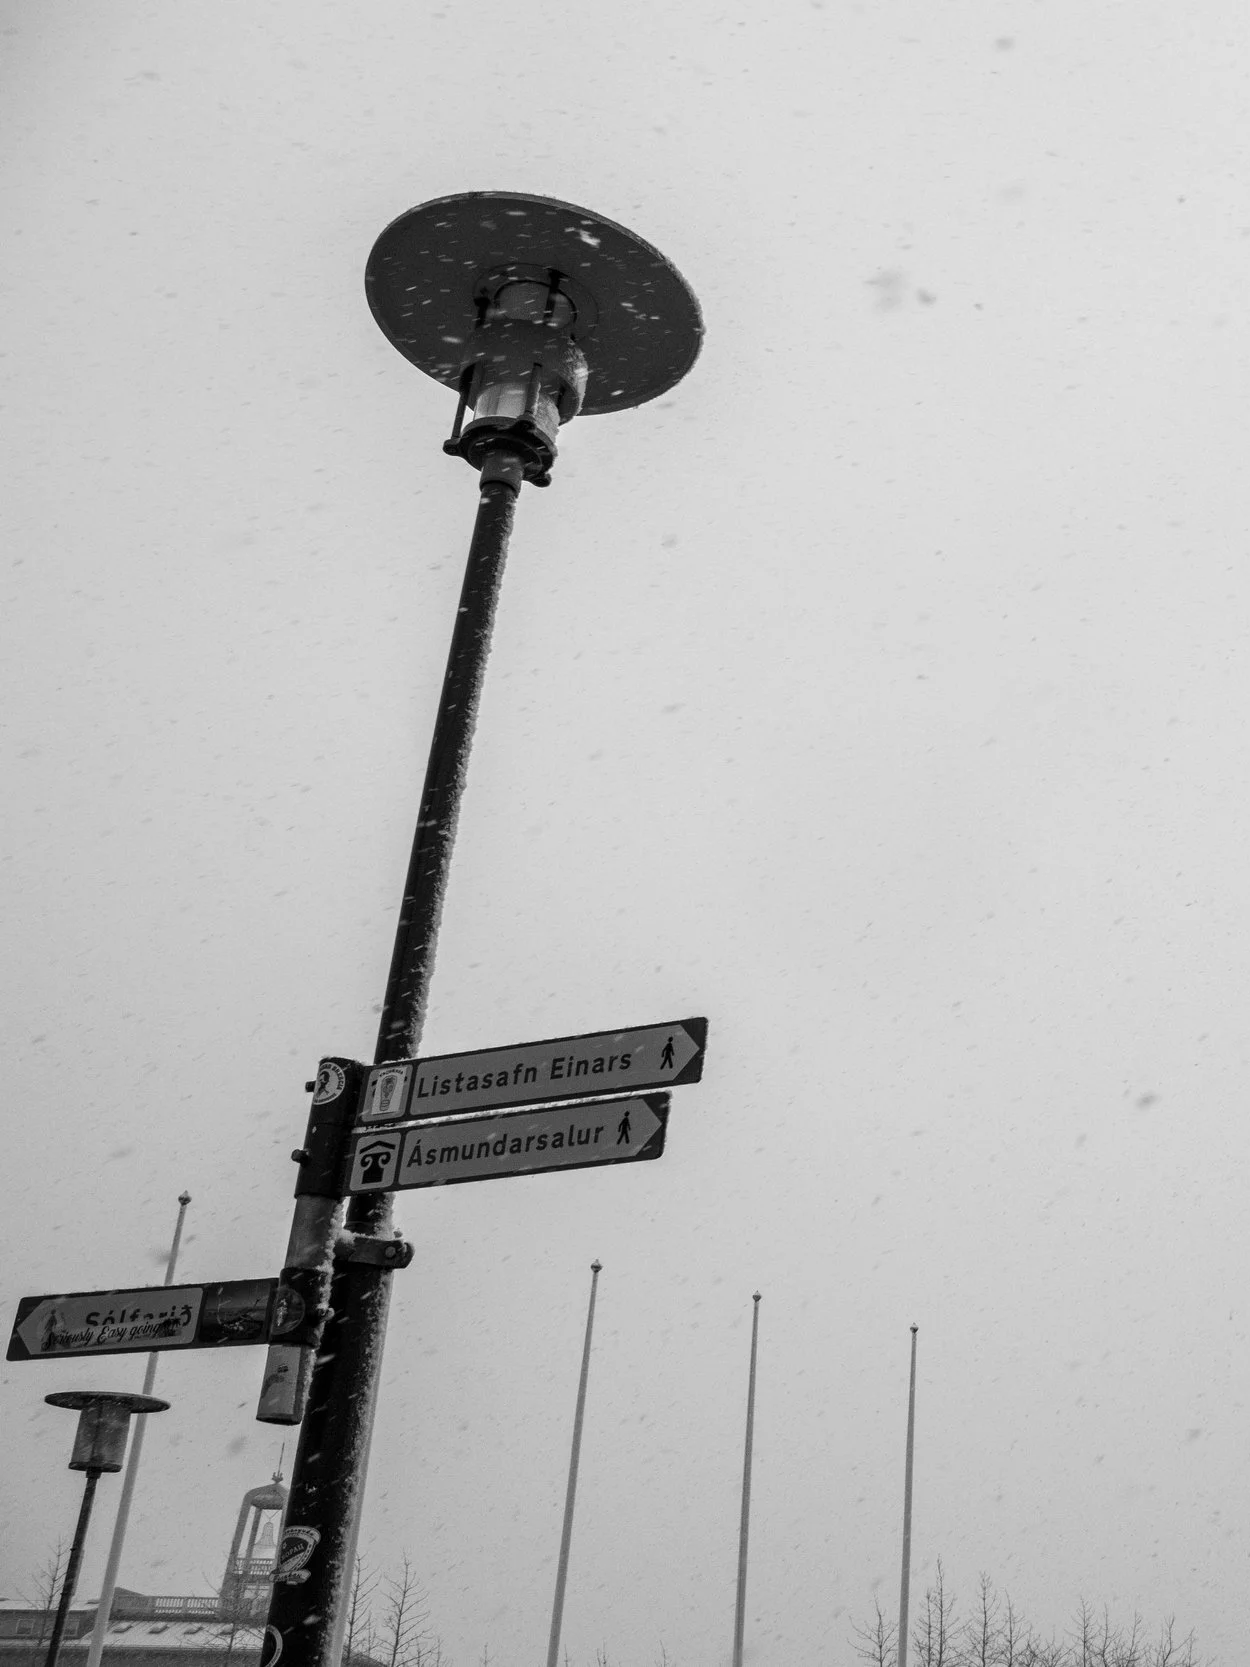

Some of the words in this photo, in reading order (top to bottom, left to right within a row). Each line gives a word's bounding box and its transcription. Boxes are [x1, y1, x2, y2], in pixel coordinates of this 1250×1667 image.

[417, 1062, 537, 1099] Listasafn
[550, 1052, 632, 1081] Einars
[406, 1123, 604, 1168] Ásmundarsalur
[41, 1327, 94, 1351] Seriously
[97, 1324, 127, 1345] Easy
[129, 1321, 161, 1341] going
